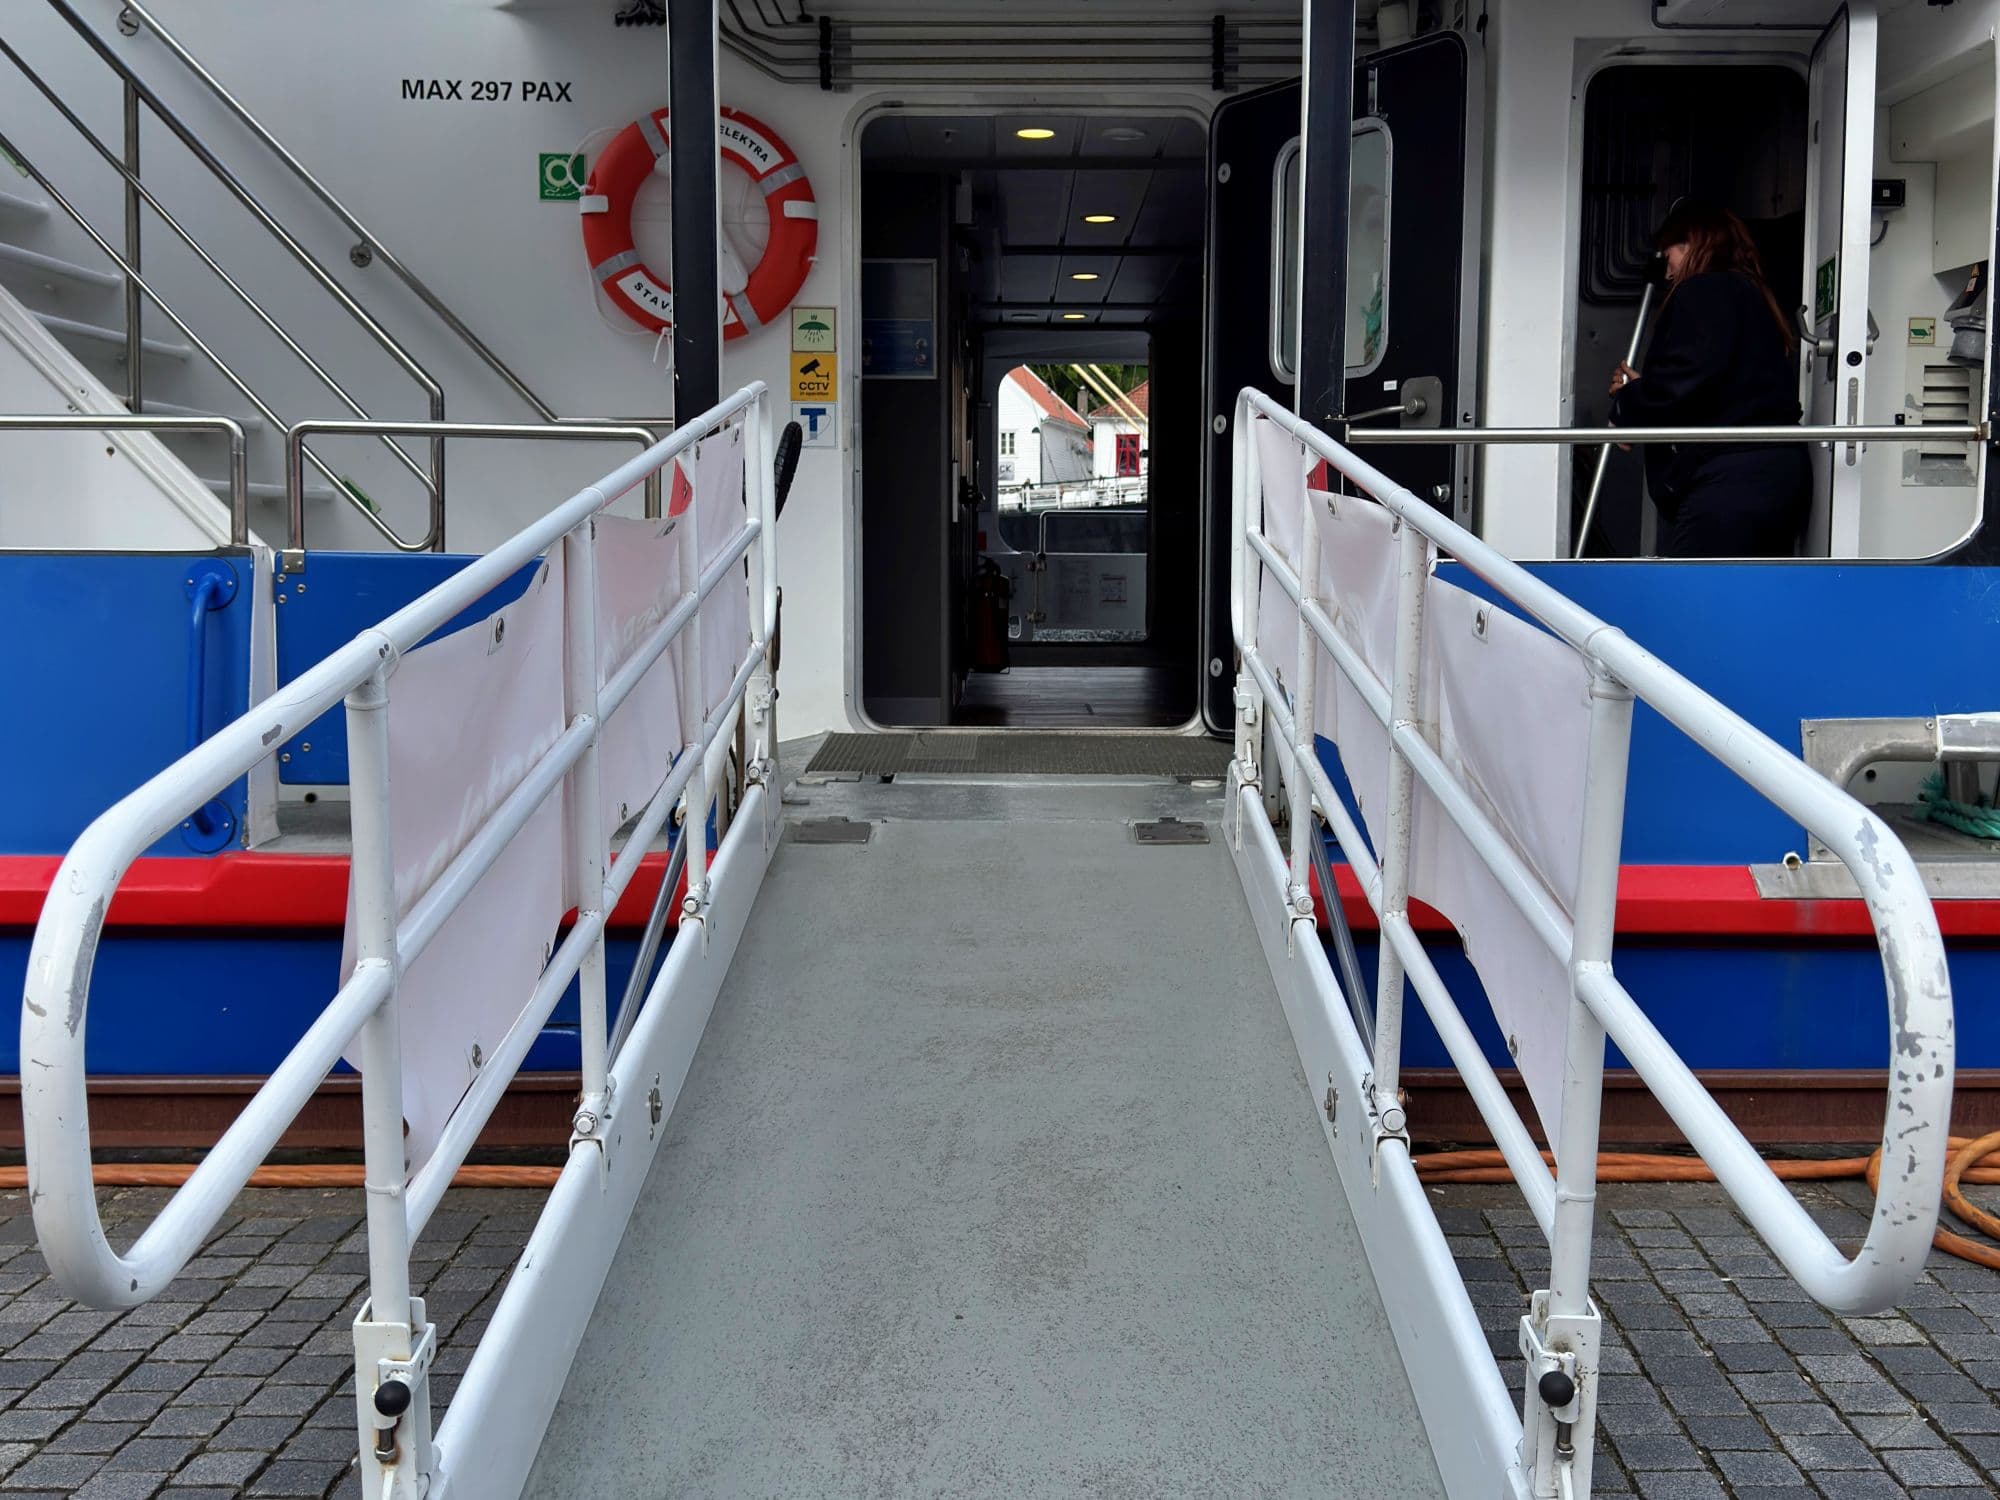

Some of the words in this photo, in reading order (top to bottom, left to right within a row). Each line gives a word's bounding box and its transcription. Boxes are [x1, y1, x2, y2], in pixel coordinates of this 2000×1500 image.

[402, 79, 463, 100] MAX
[471, 81, 513, 101] 297
[522, 81, 573, 102] PAX
[634, 281, 673, 313] STAV
[799, 382, 830, 391] CCTV
